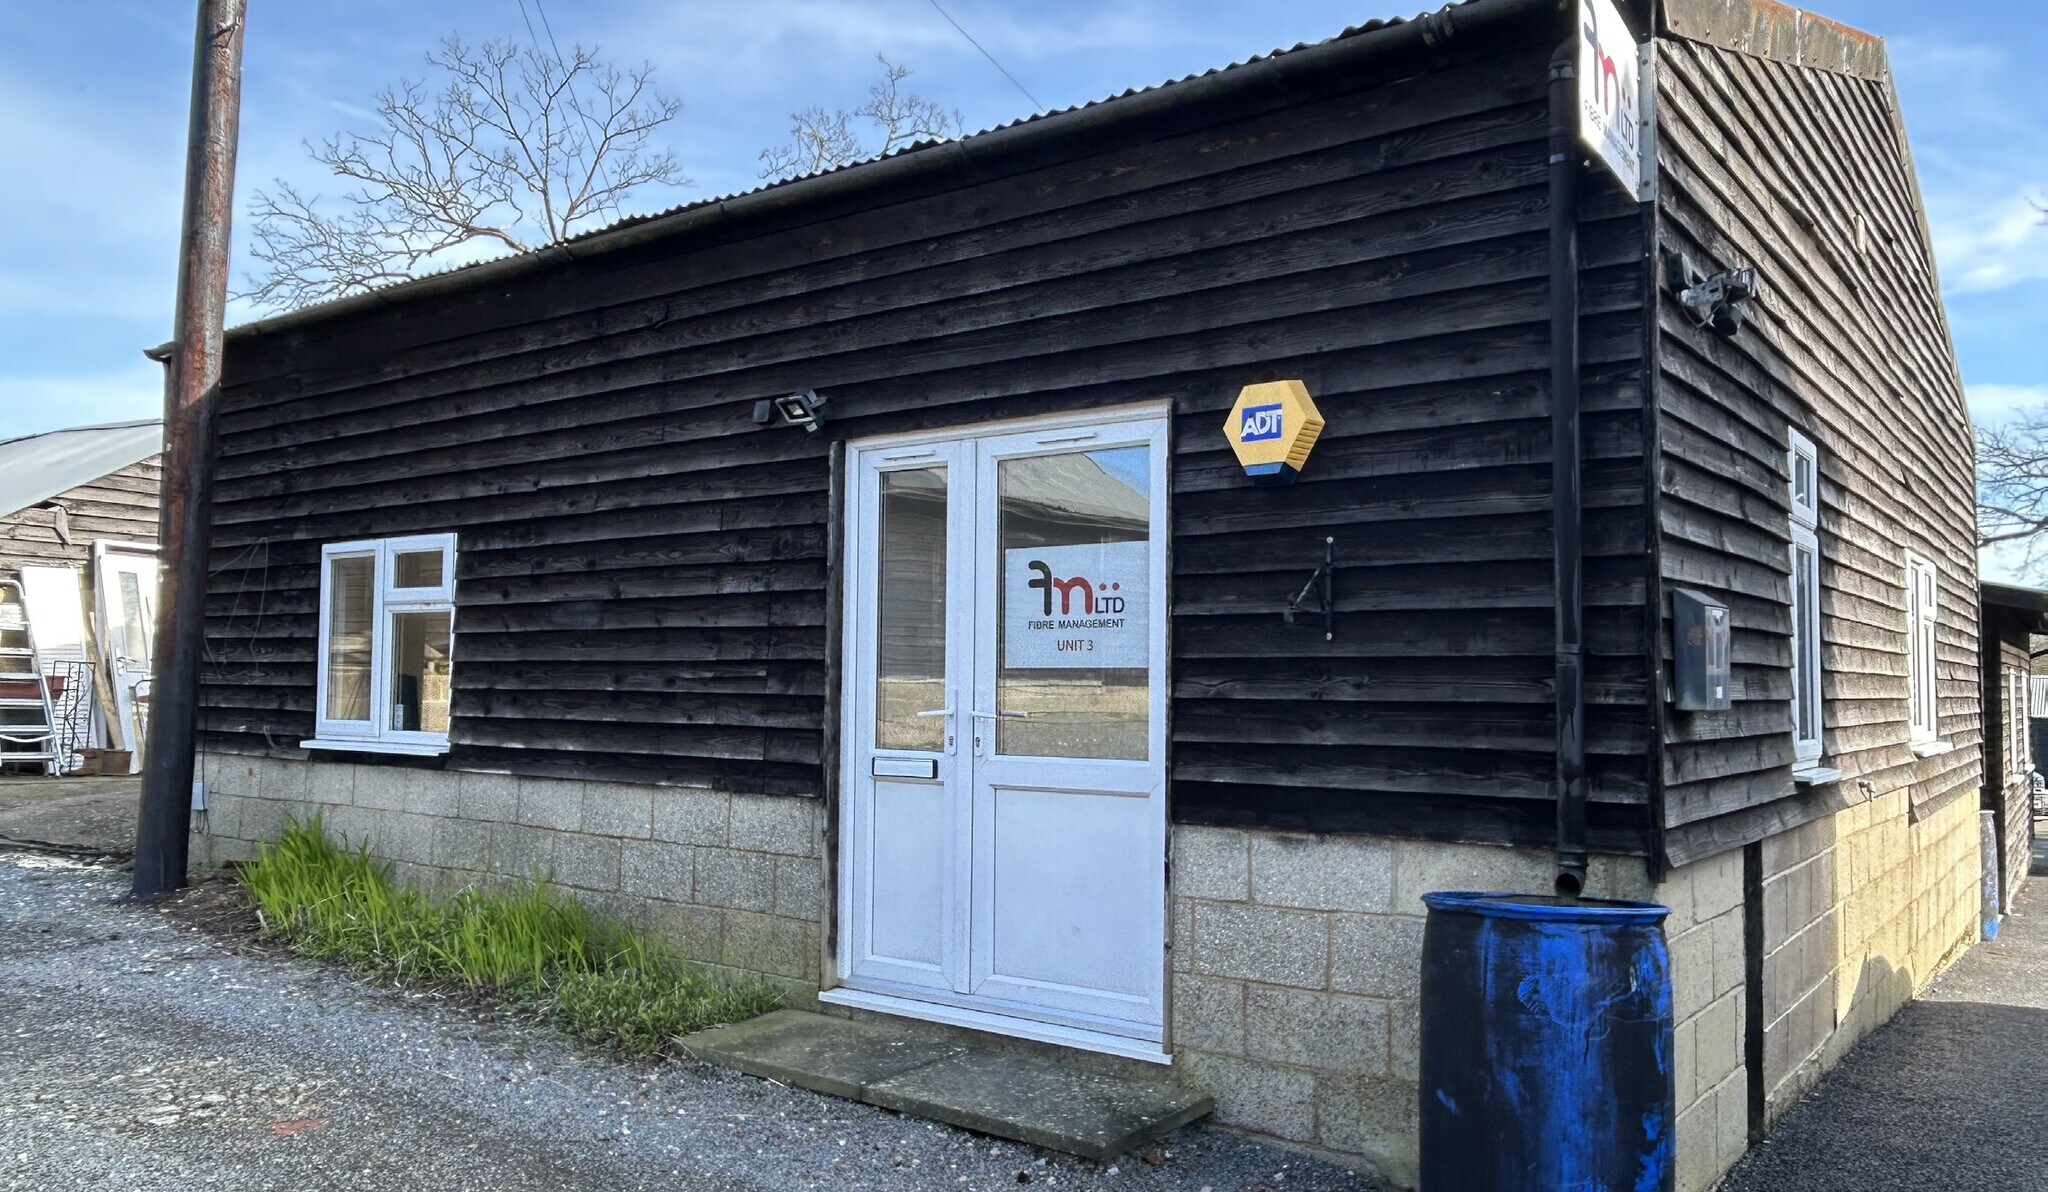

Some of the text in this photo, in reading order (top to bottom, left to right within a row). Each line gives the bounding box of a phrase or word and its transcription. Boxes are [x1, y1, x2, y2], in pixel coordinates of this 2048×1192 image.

[1621, 109, 1634, 150] LTD
[1240, 409, 1282, 438] ADT
[1094, 596, 1125, 614] LTD
[1028, 618, 1125, 630] FIBRE MANAGEMENT
[1057, 639, 1094, 651] UNIT 3
